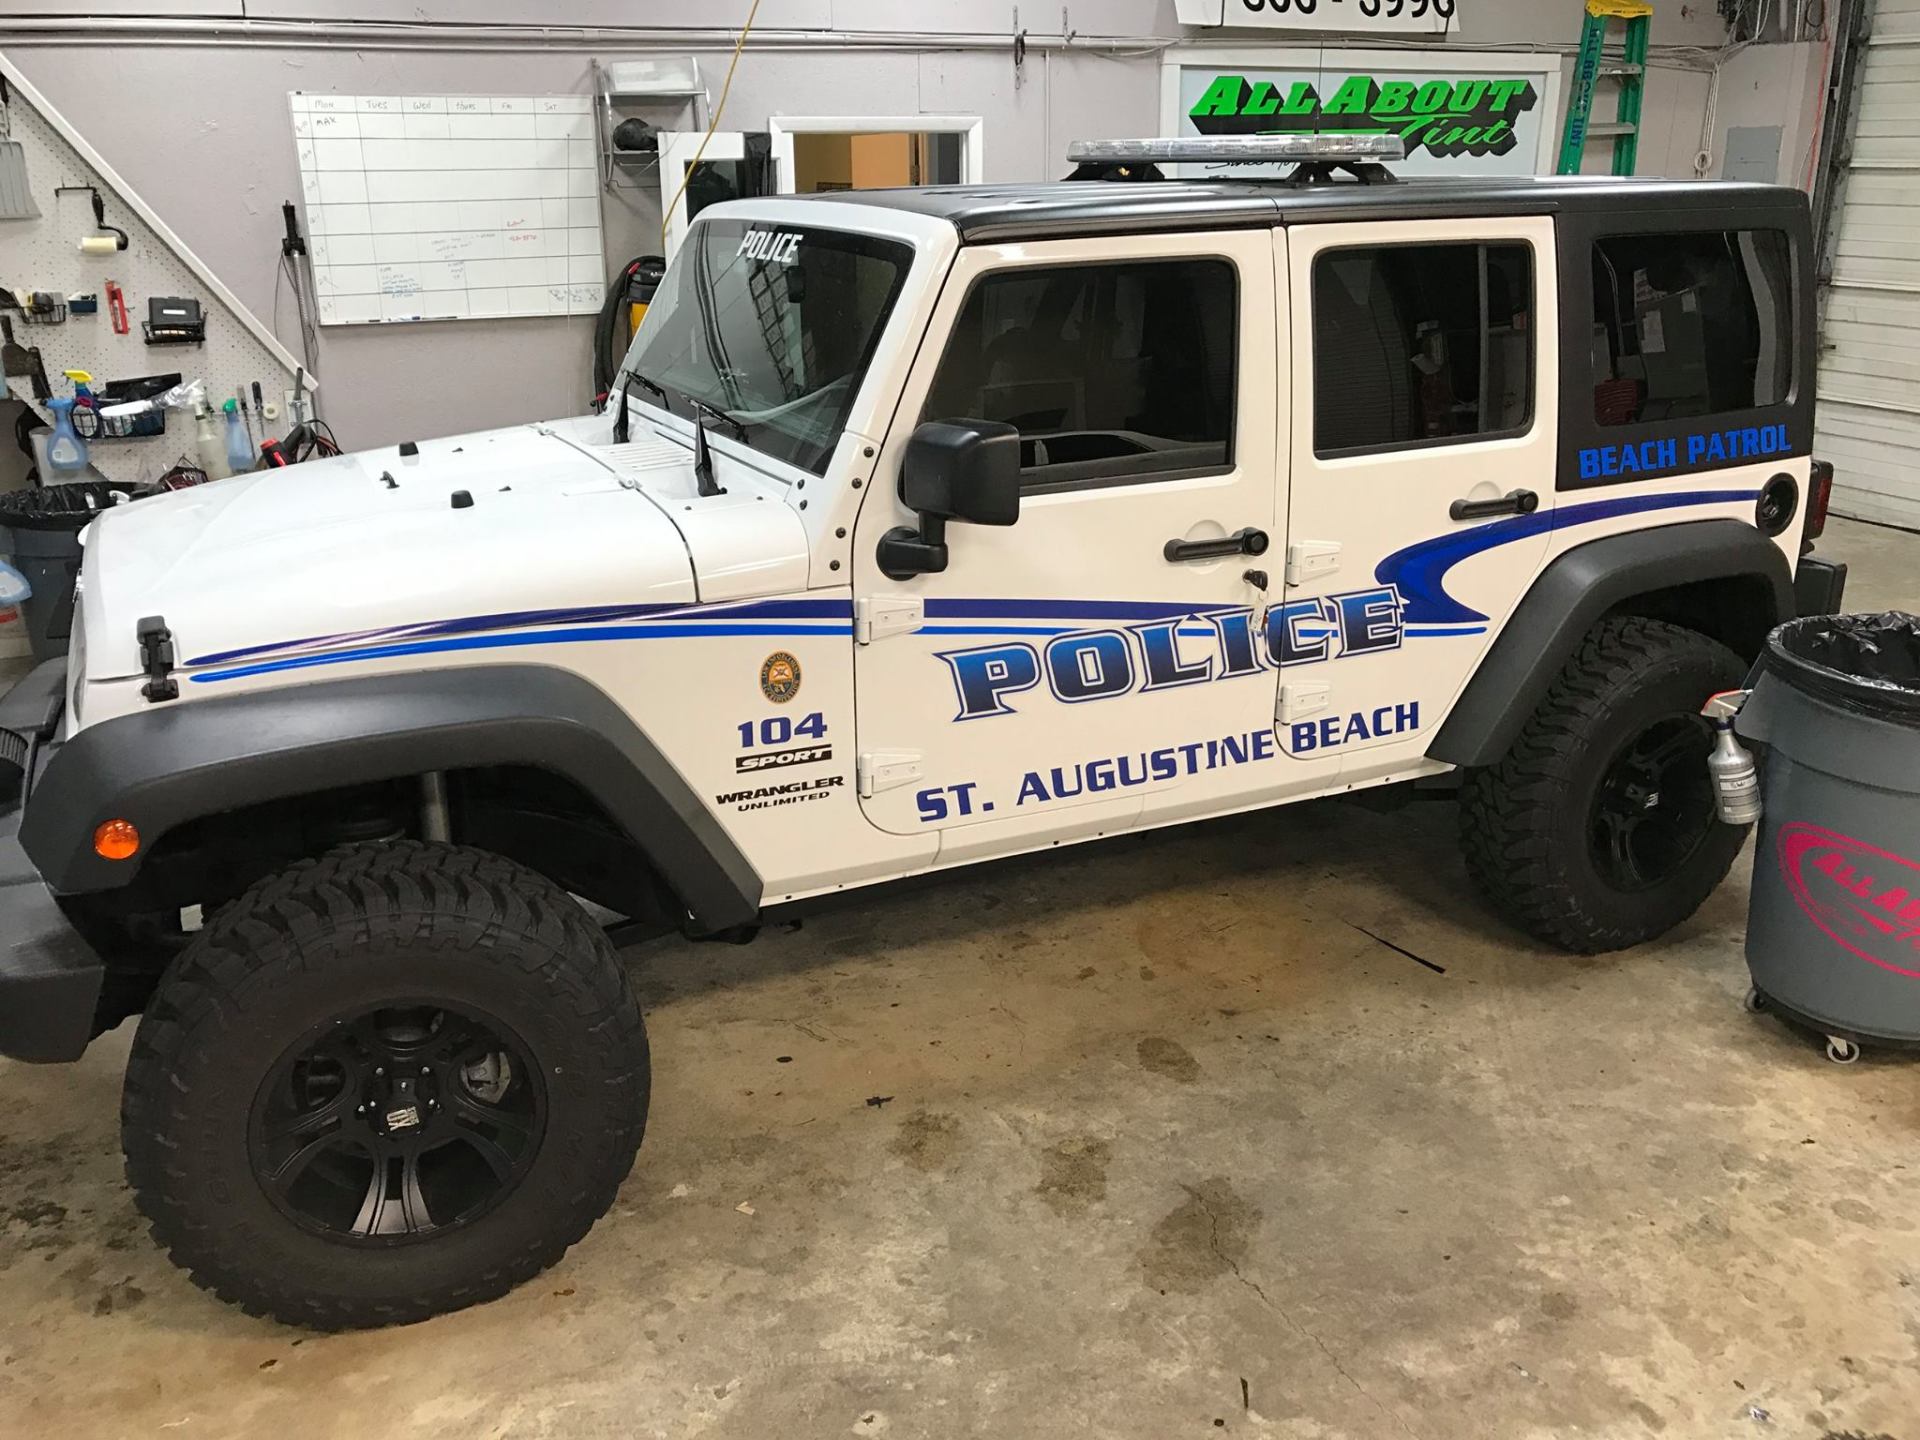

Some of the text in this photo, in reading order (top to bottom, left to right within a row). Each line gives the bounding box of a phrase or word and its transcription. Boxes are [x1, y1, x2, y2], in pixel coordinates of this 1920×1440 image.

[1189, 75, 1530, 117] ALL ABOUT
[1374, 114, 1517, 146] Tint
[736, 230, 803, 262] POLICE
[1579, 424, 1793, 480] BEACH PATROL
[933, 583, 1409, 722] POLICE
[737, 712, 828, 748] 104
[740, 748, 827, 770] SPORT
[916, 701, 1419, 822] ST. AUGUSTINE BEACH
[715, 775, 845, 805] WRANGLER
[737, 791, 830, 812] UNLIMITED
[1811, 852, 1873, 899] ALL
